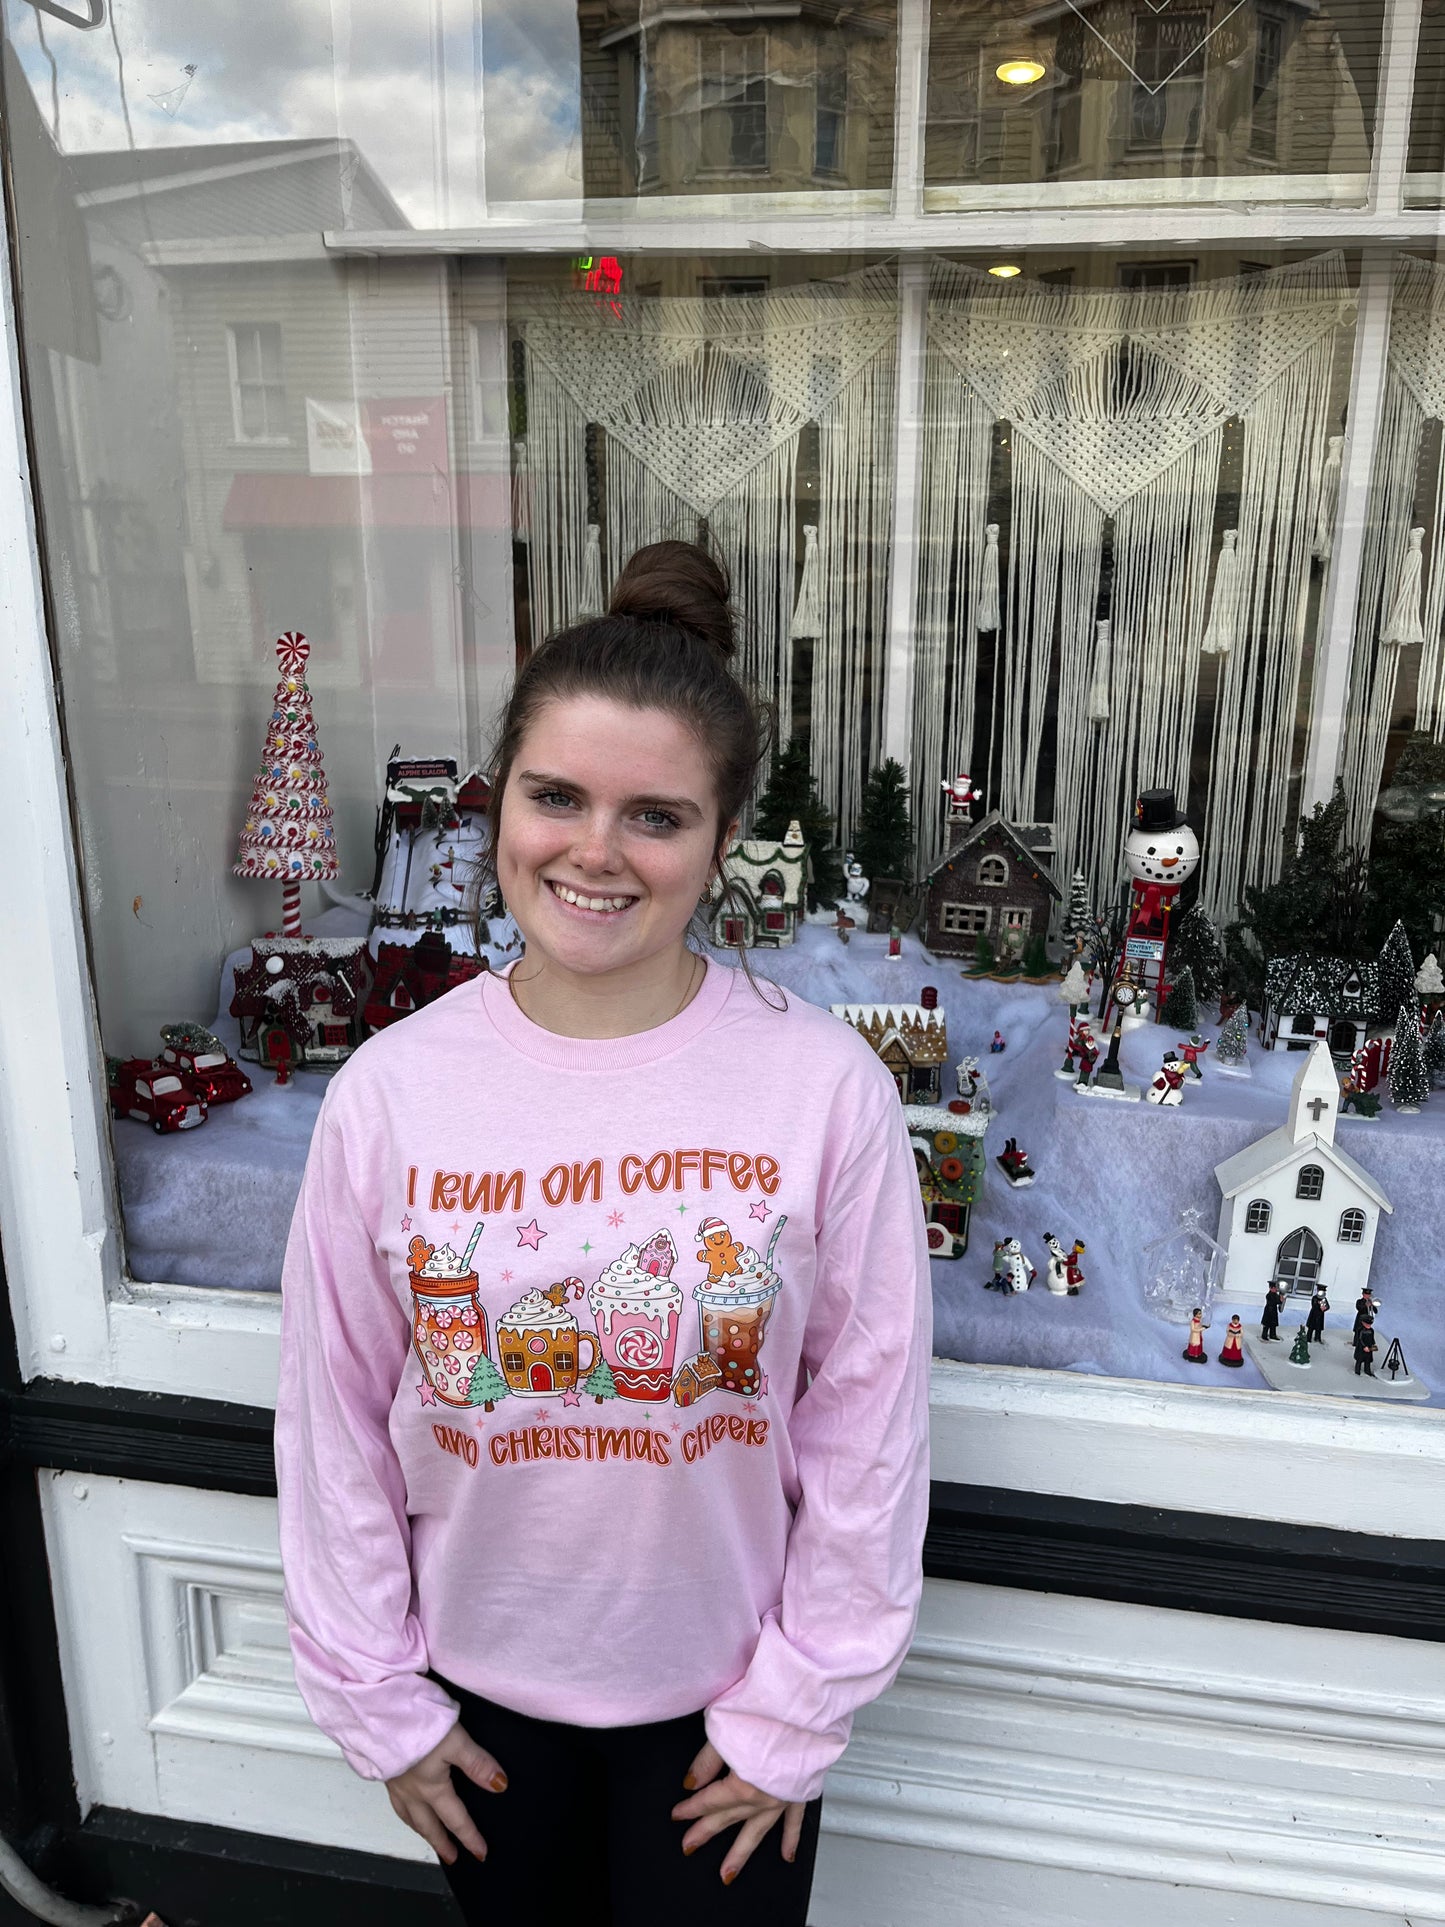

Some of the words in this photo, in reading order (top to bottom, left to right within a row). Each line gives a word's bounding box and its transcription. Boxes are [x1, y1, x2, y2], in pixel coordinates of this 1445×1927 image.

[397, 769, 421, 777] ALPINE
[421, 768, 448, 776] SLALOM
[1127, 943, 1152, 951] CONTEST
[407, 1165, 419, 1208] I
[429, 1168, 527, 1214] RUN
[540, 1157, 604, 1208] ON
[618, 1148, 782, 1196] COFFEE
[431, 1422, 480, 1470] AND
[489, 1424, 672, 1467] CHRISTMAS
[681, 1412, 770, 1465] CHEER
